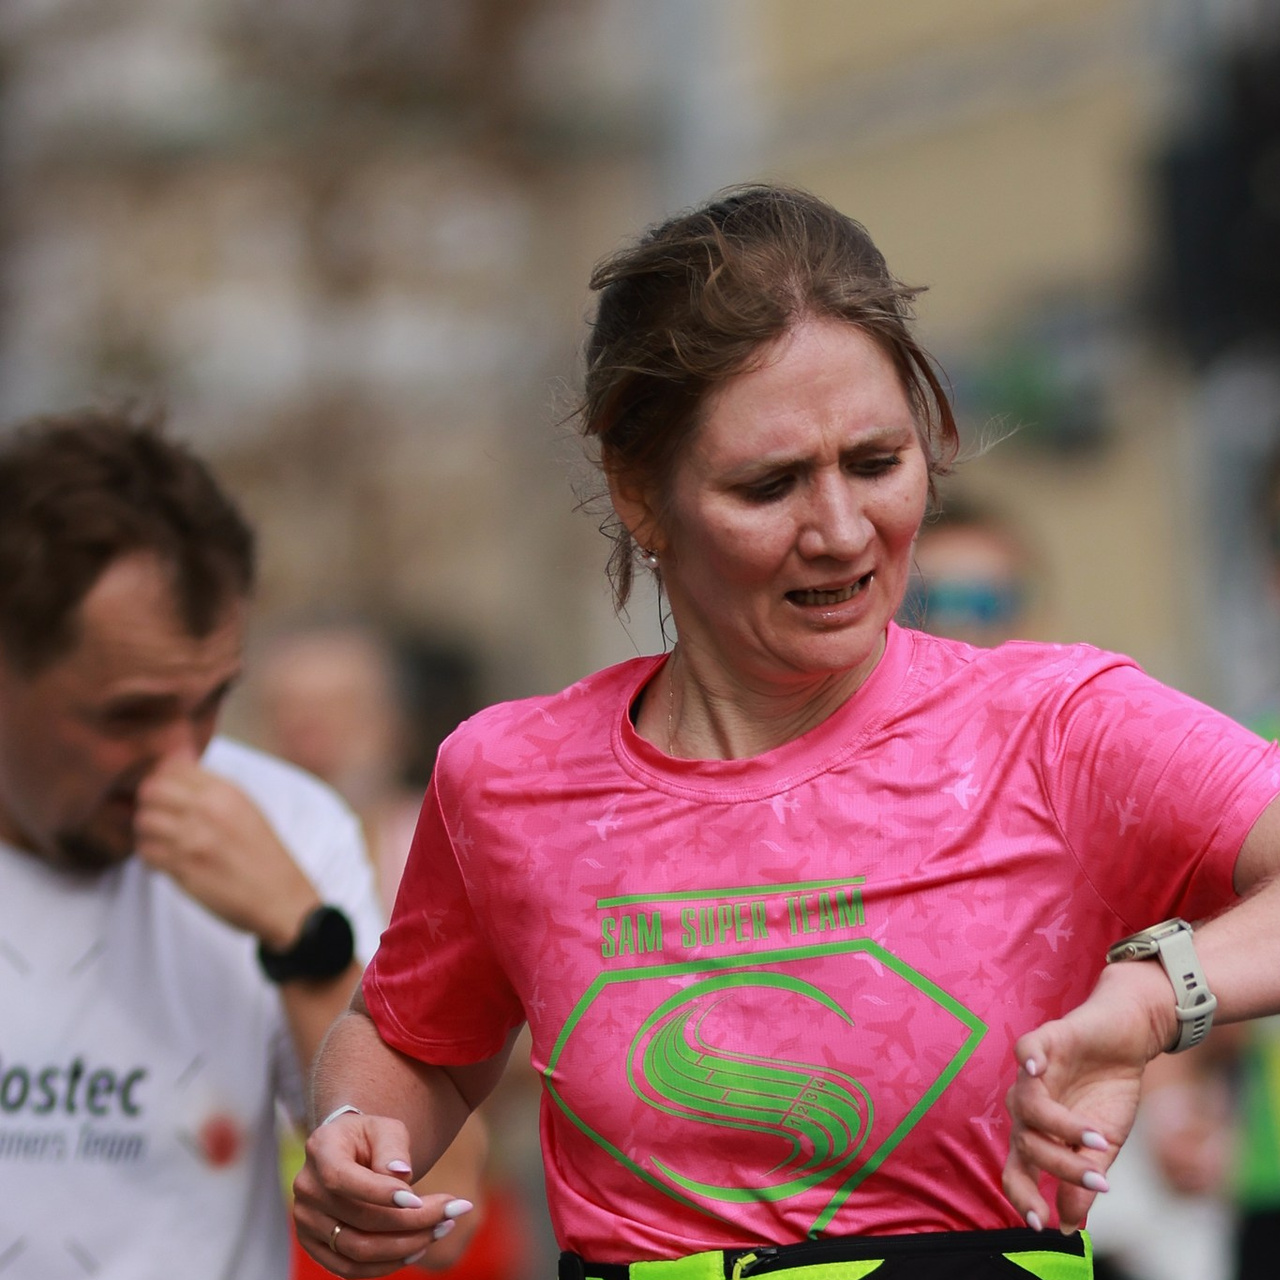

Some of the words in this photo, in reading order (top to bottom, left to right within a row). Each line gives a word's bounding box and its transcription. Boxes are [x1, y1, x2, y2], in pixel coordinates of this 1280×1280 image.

[601, 911, 663, 958] SAM
[681, 900, 769, 949] SUPER
[785, 887, 866, 936] TEAM
[0, 1055, 147, 1116] ostec
